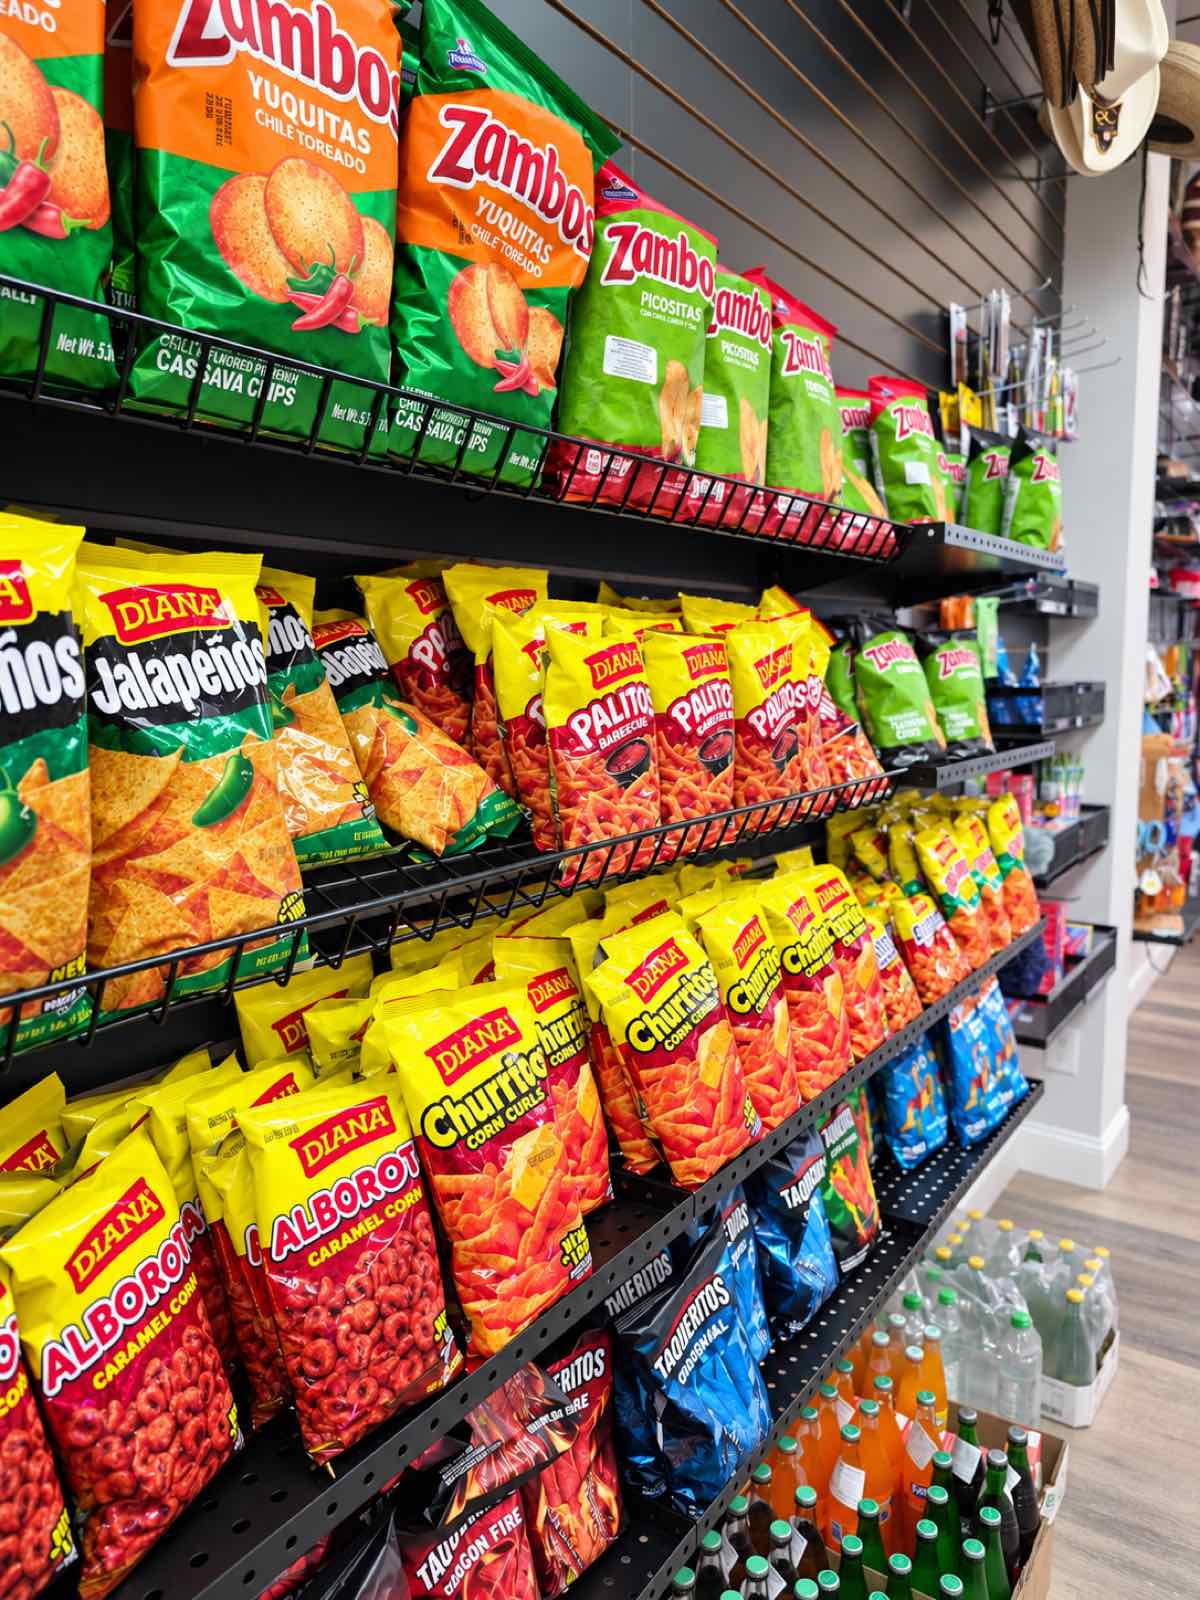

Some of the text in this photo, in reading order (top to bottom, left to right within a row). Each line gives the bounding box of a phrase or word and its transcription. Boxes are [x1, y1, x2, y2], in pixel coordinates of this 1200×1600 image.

[247, 70, 372, 155] YUQUITAS
[254, 107, 297, 141] CHILE
[296, 126, 367, 175] TOREADO
[471, 223, 544, 278] CHILE TOREADO
[474, 195, 552, 265] YUQUITAS
[601, 222, 716, 303] Zambo
[640, 290, 703, 322] PICOSITAS
[116, 591, 217, 632] DIANA
[91, 633, 268, 715] Jalapeños
[593, 650, 643, 682] DIANA
[688, 650, 727, 674] DIANA
[631, 947, 684, 997] DIANA
[436, 1015, 516, 1077] DIANA
[663, 1021, 695, 1052] CORN
[303, 1105, 390, 1167] DIANA
[466, 1087, 546, 1150] CORN CURLS
[72, 1191, 160, 1282] DIANA
[308, 1186, 424, 1267] CARAMEL CORN
[92, 1272, 199, 1390] CARAMEL CORN
[488, 1506, 523, 1543] FIRE
